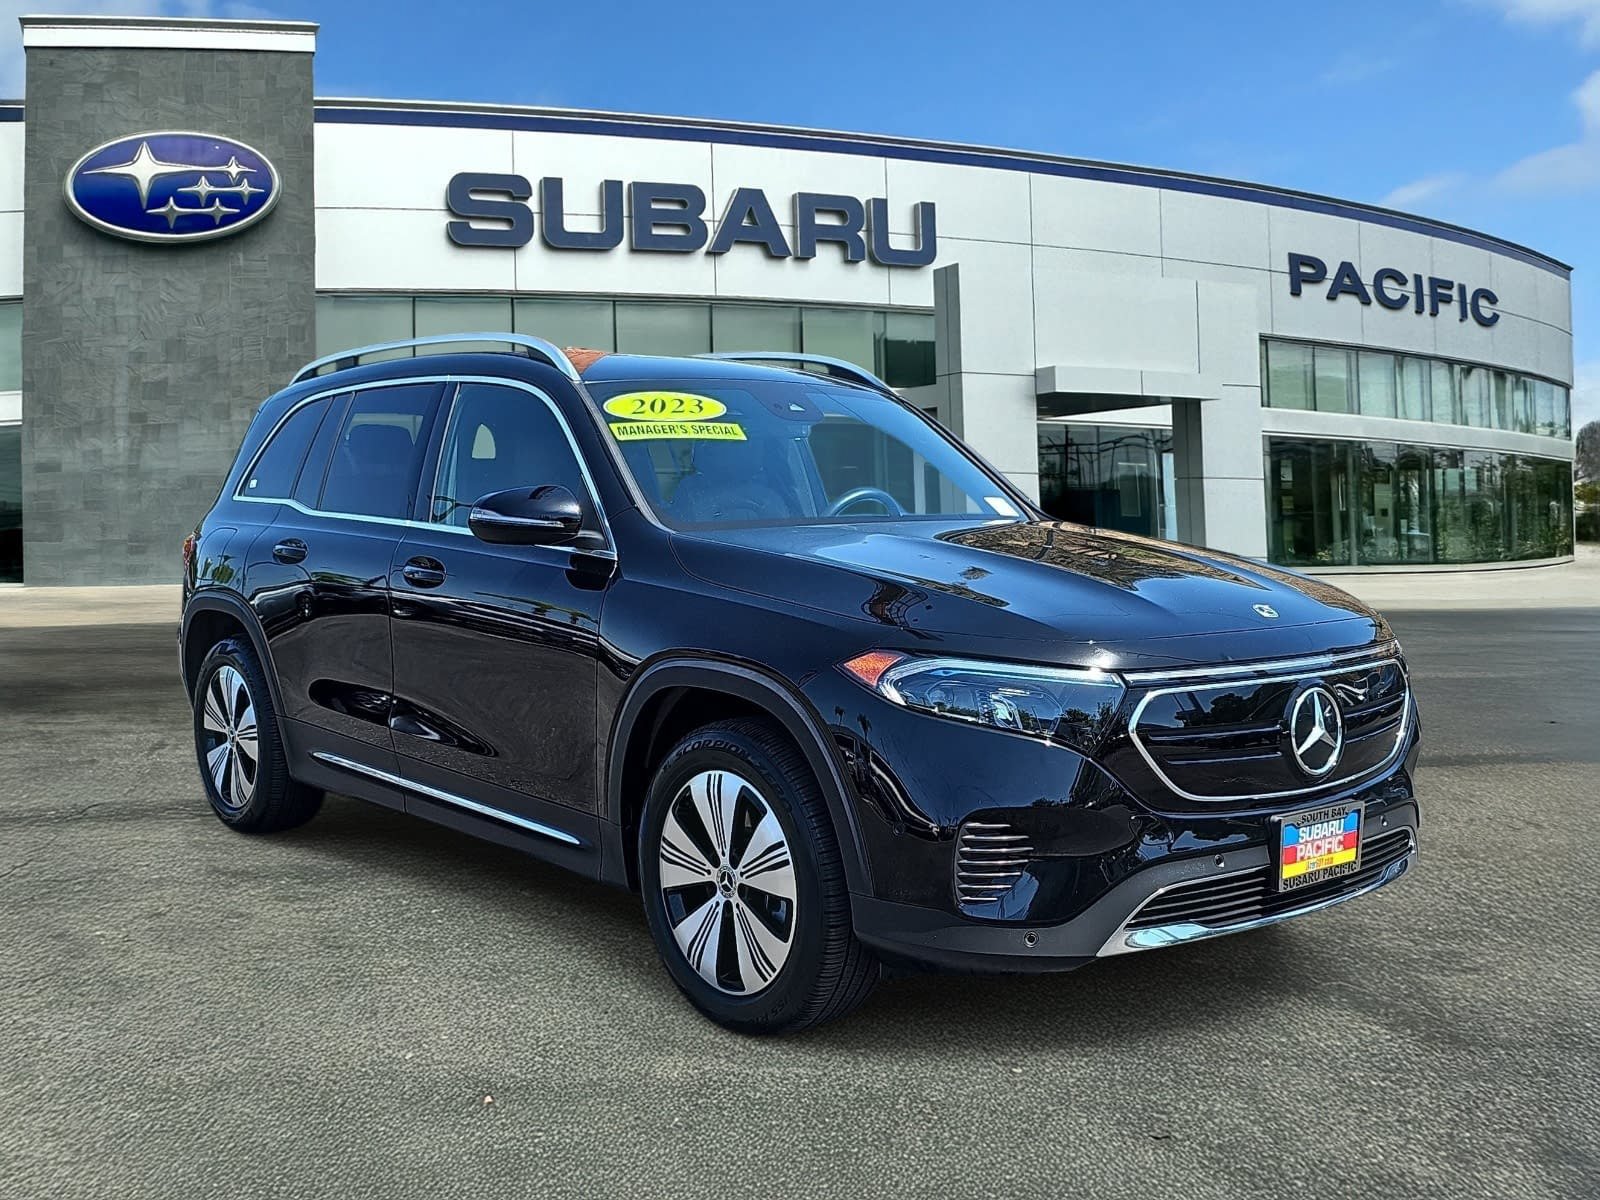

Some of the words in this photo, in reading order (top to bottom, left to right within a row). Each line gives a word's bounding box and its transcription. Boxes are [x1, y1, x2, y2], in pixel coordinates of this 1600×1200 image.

[446, 171, 937, 267] SUBARU
[1287, 252, 1500, 327] PACIFIC
[631, 398, 704, 415] 2023
[617, 424, 688, 436] MANAGER'S
[691, 424, 738, 435] SPECIAL
[1301, 809, 1329, 823] SOUTH
[1331, 806, 1347, 818] BAY
[1298, 819, 1345, 843] SUBARU
[1296, 835, 1344, 861] PACIFIC
[1282, 871, 1320, 890] SUBARU
[1322, 861, 1357, 879] PACIFIC
